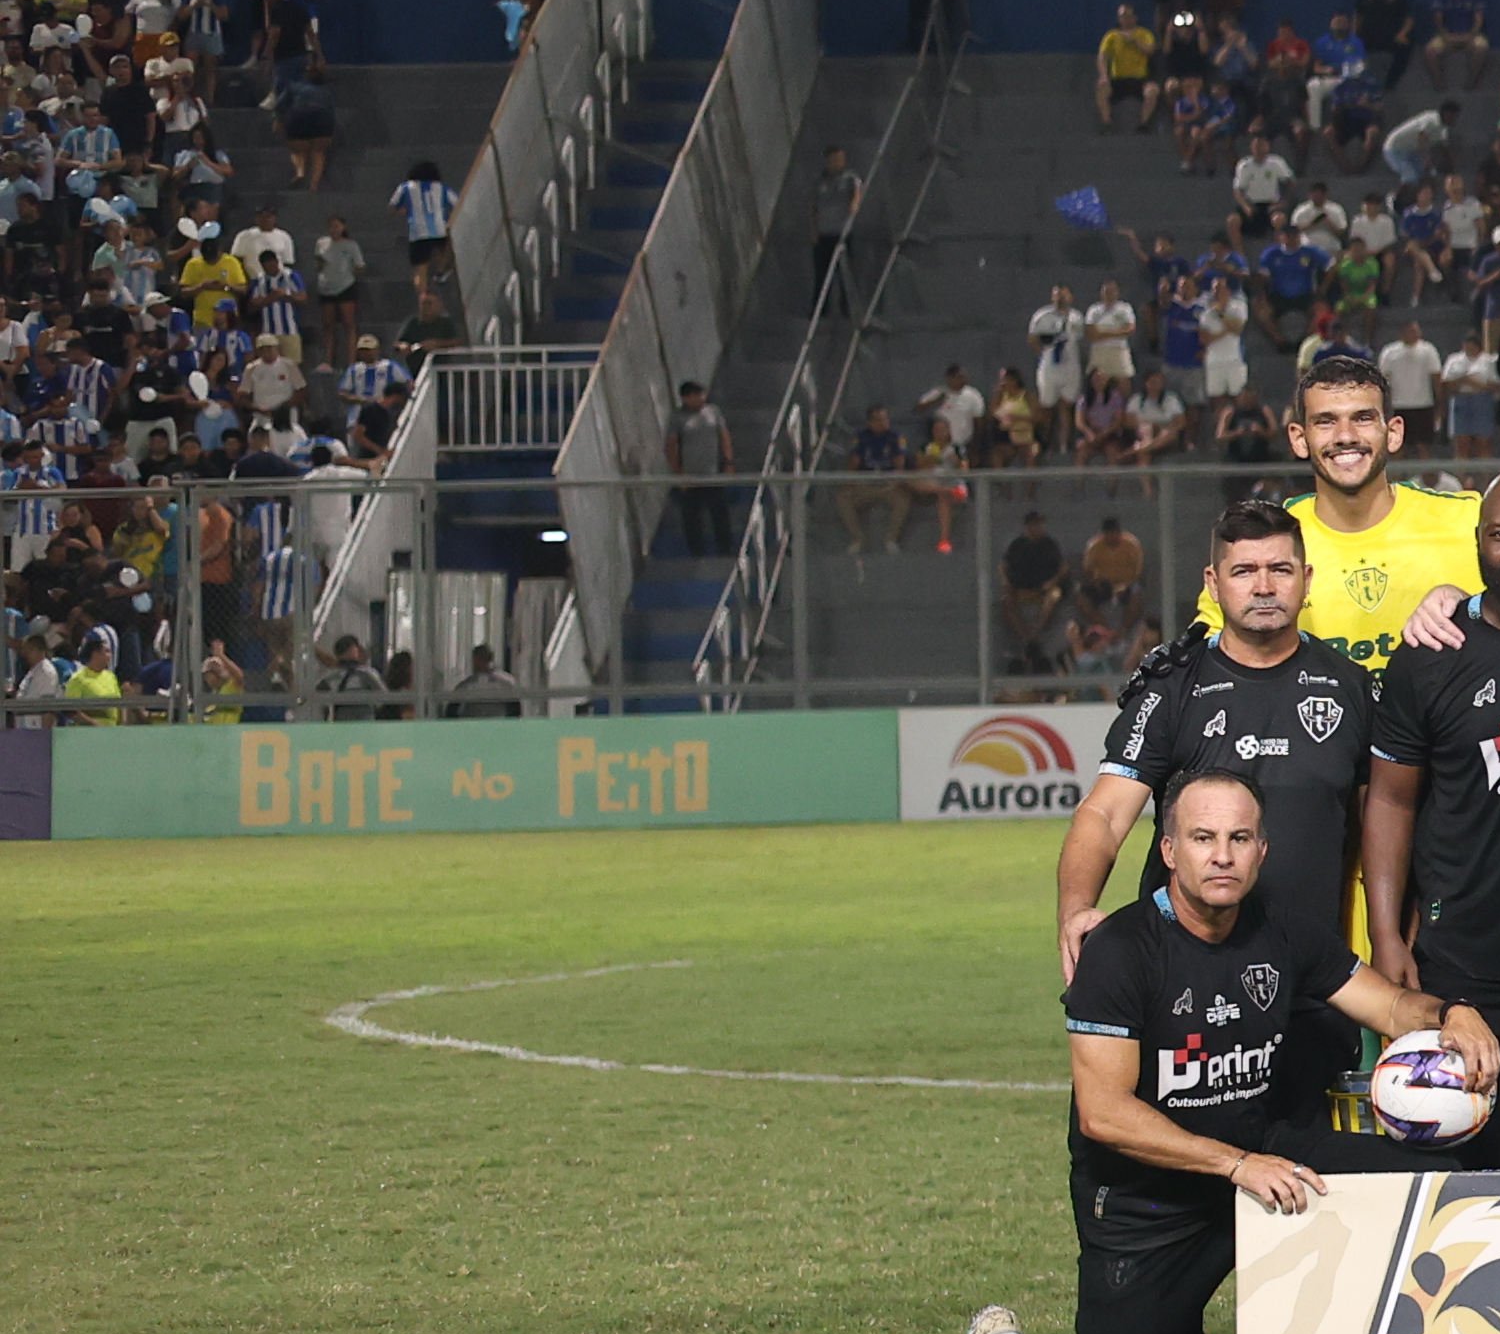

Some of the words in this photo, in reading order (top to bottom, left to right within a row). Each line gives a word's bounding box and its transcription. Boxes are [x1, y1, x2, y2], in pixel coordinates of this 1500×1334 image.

[1123, 692, 1159, 760] DIMAGEM
[939, 779, 1081, 814] Aurora
[1224, 1089, 1236, 1101] de
